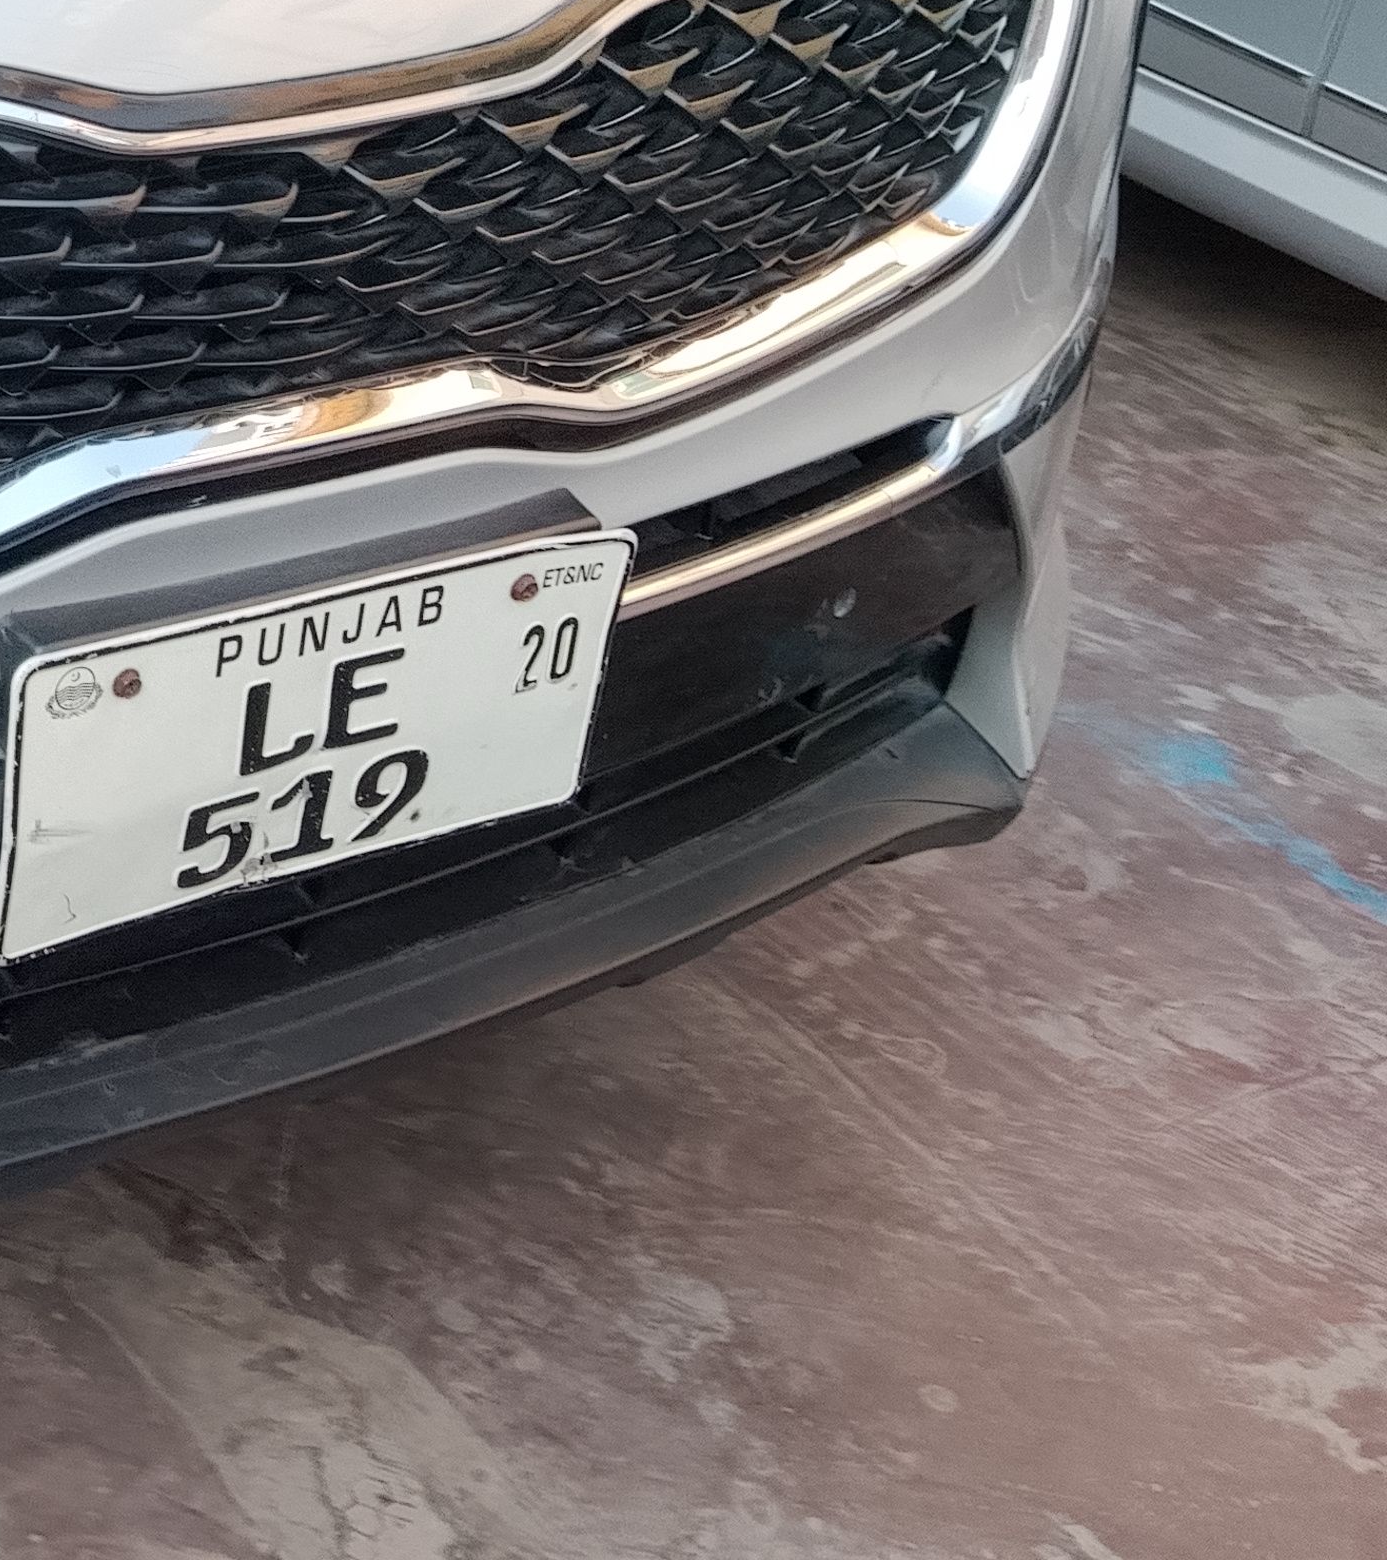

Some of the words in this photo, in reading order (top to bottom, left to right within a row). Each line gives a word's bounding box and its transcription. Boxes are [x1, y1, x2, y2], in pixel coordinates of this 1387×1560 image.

[542, 562, 604, 588] ET&NC
[215, 585, 444, 678] PUNJAB
[515, 616, 579, 693] 20
[239, 647, 405, 776] LE
[177, 749, 429, 888] 519
